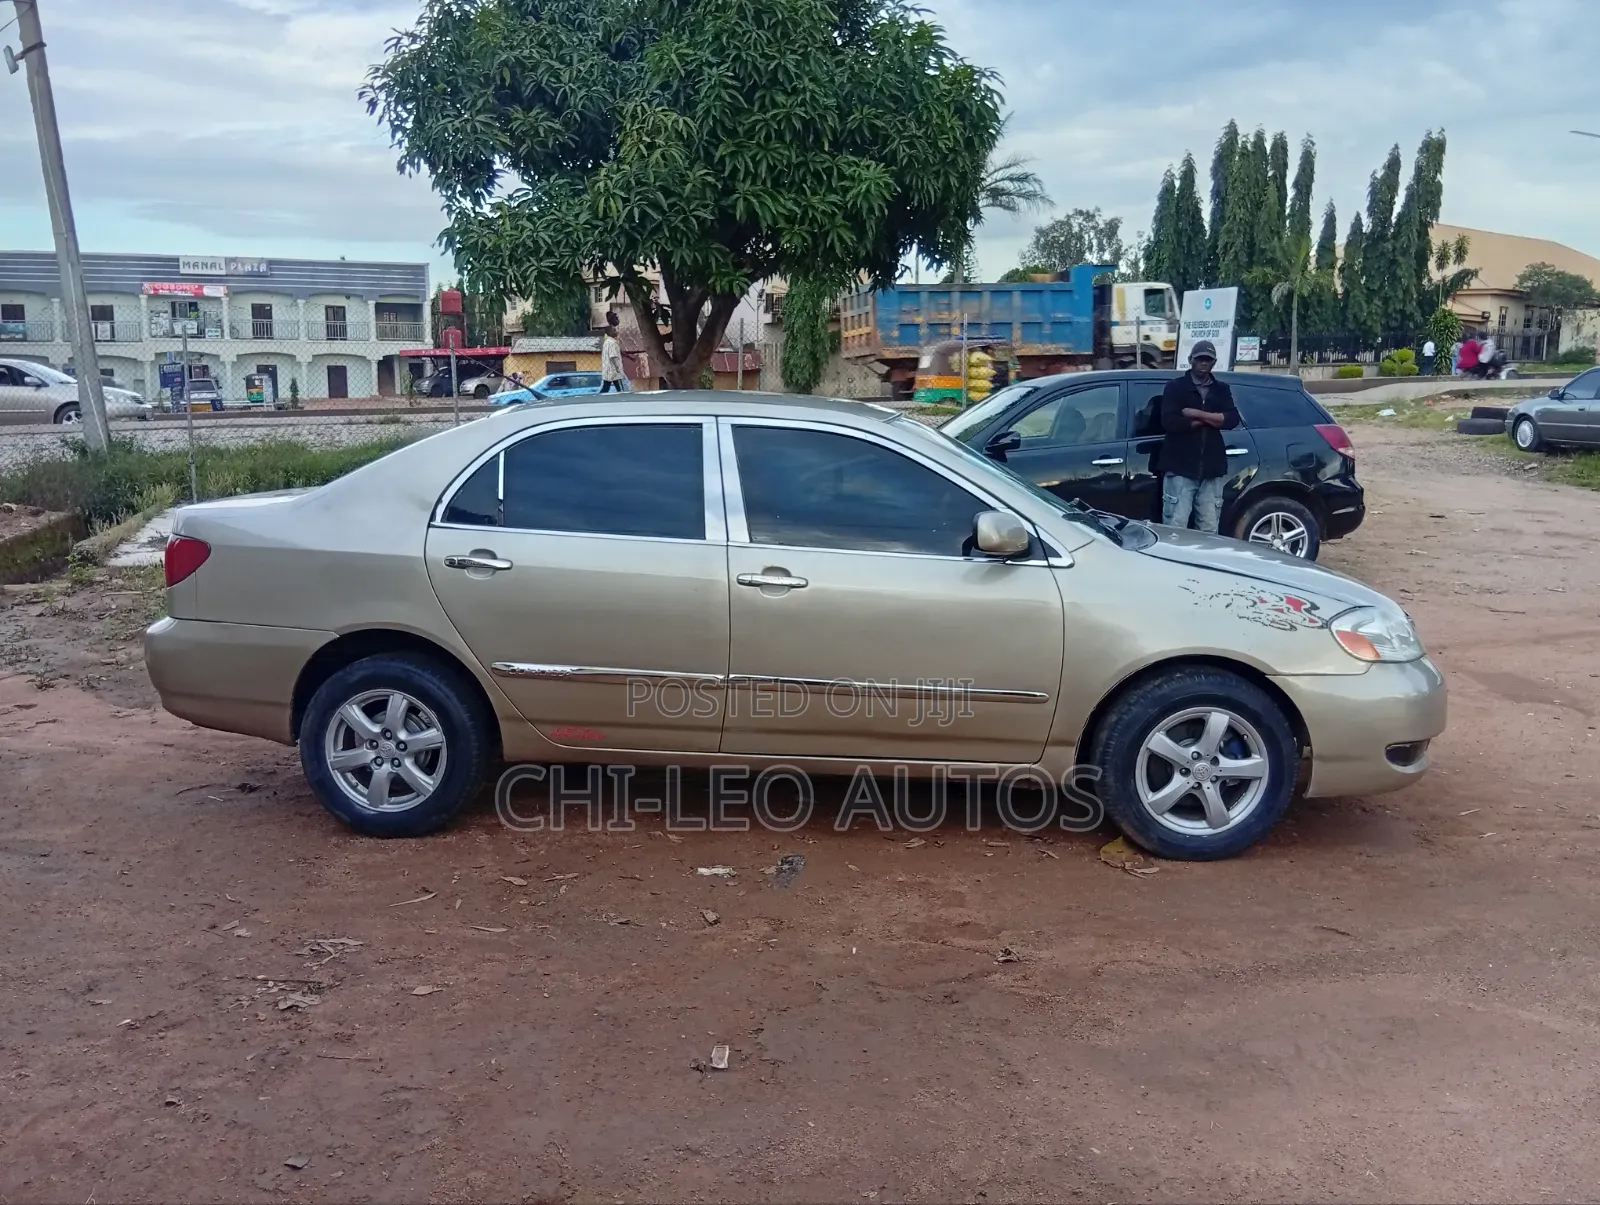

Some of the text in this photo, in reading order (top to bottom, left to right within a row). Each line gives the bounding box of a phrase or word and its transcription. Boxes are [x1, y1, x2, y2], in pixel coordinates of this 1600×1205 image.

[182, 260, 267, 272] MANAL PLAZA
[1191, 320, 1210, 329] REDEEMED
[1211, 320, 1228, 328] CHRISTIAN
[1191, 329, 1206, 338] CHURCH
